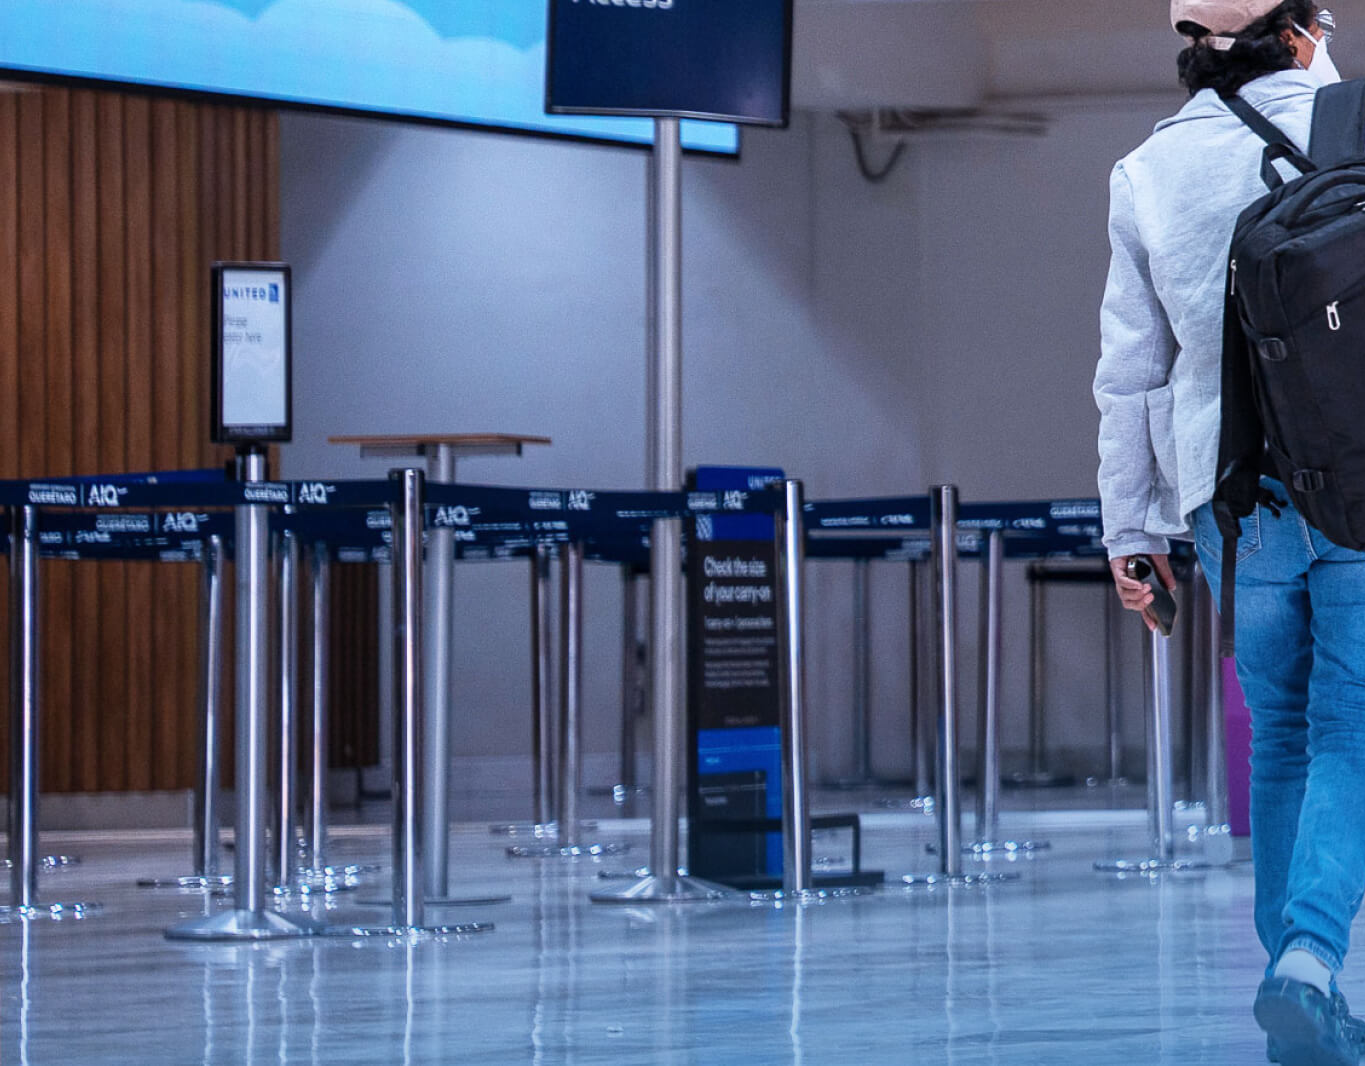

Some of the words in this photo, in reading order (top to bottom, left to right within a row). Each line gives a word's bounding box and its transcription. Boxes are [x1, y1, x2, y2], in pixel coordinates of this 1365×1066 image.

[223, 287, 267, 300] UNITED
[88, 484, 120, 506] AIQ
[299, 482, 328, 504] AIQ
[163, 512, 198, 532] AIQ
[704, 555, 732, 577] Check
[734, 556, 748, 577] the
